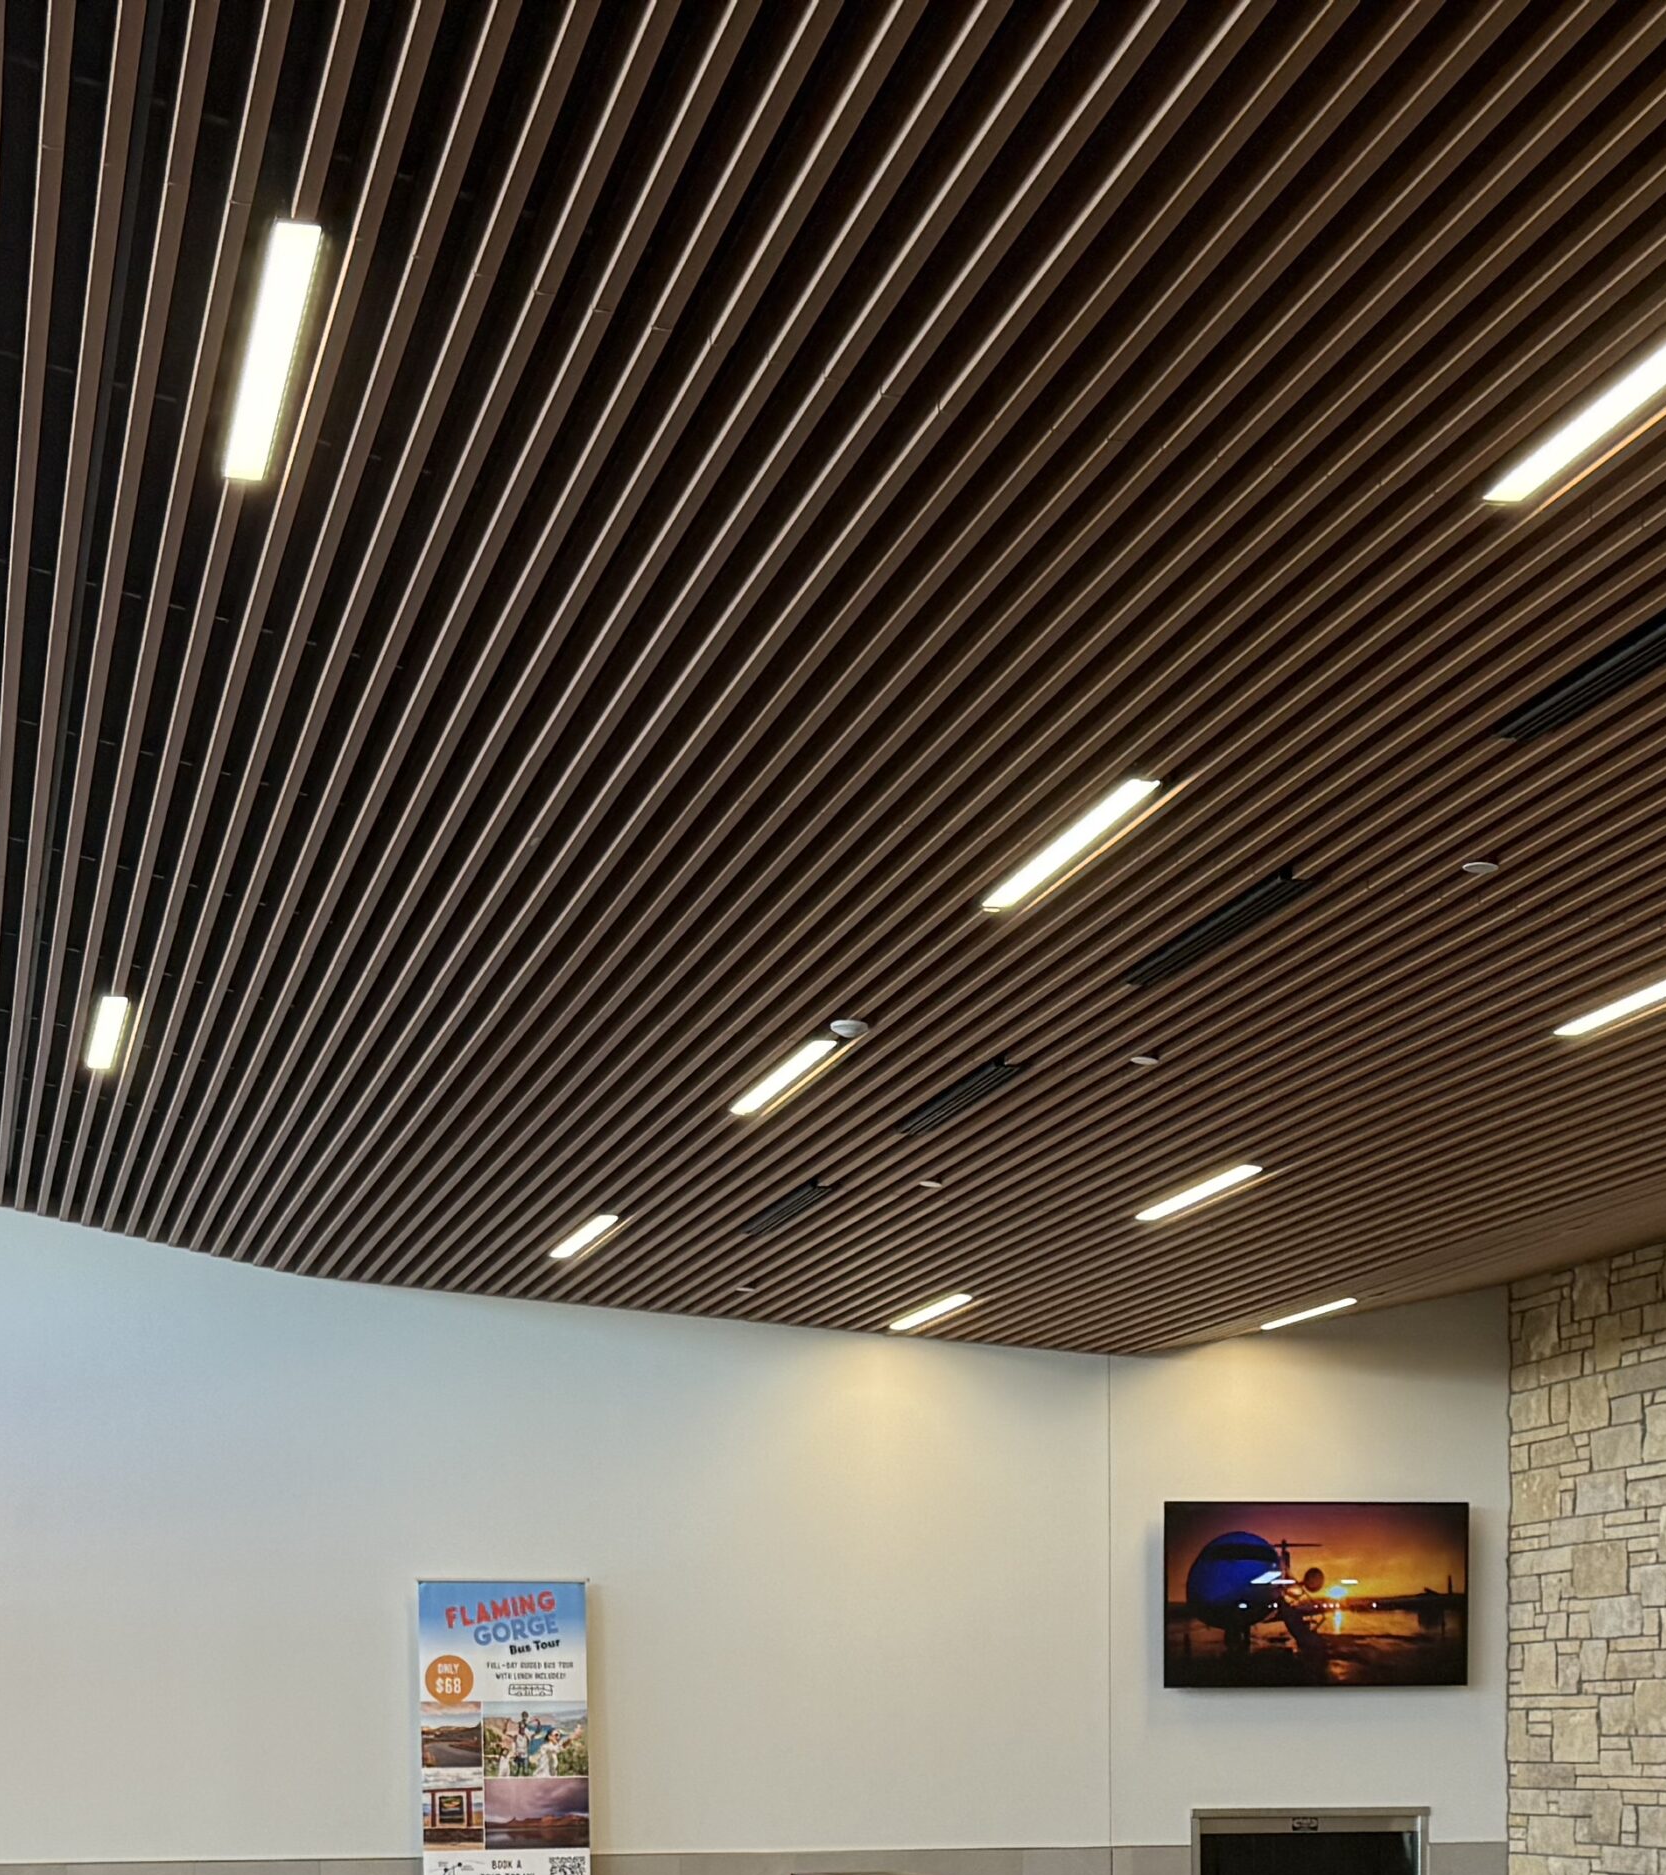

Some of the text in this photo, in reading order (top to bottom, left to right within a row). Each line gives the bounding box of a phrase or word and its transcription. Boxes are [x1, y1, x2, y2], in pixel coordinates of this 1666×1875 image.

[445, 1590, 556, 1629] FLAMING
[474, 1614, 559, 1646] GORGE
[509, 1639, 560, 1655] Bus Tour
[437, 1663, 460, 1675] ONLY
[435, 1677, 461, 1694] $68
[491, 1859, 523, 1869] BOOK A
